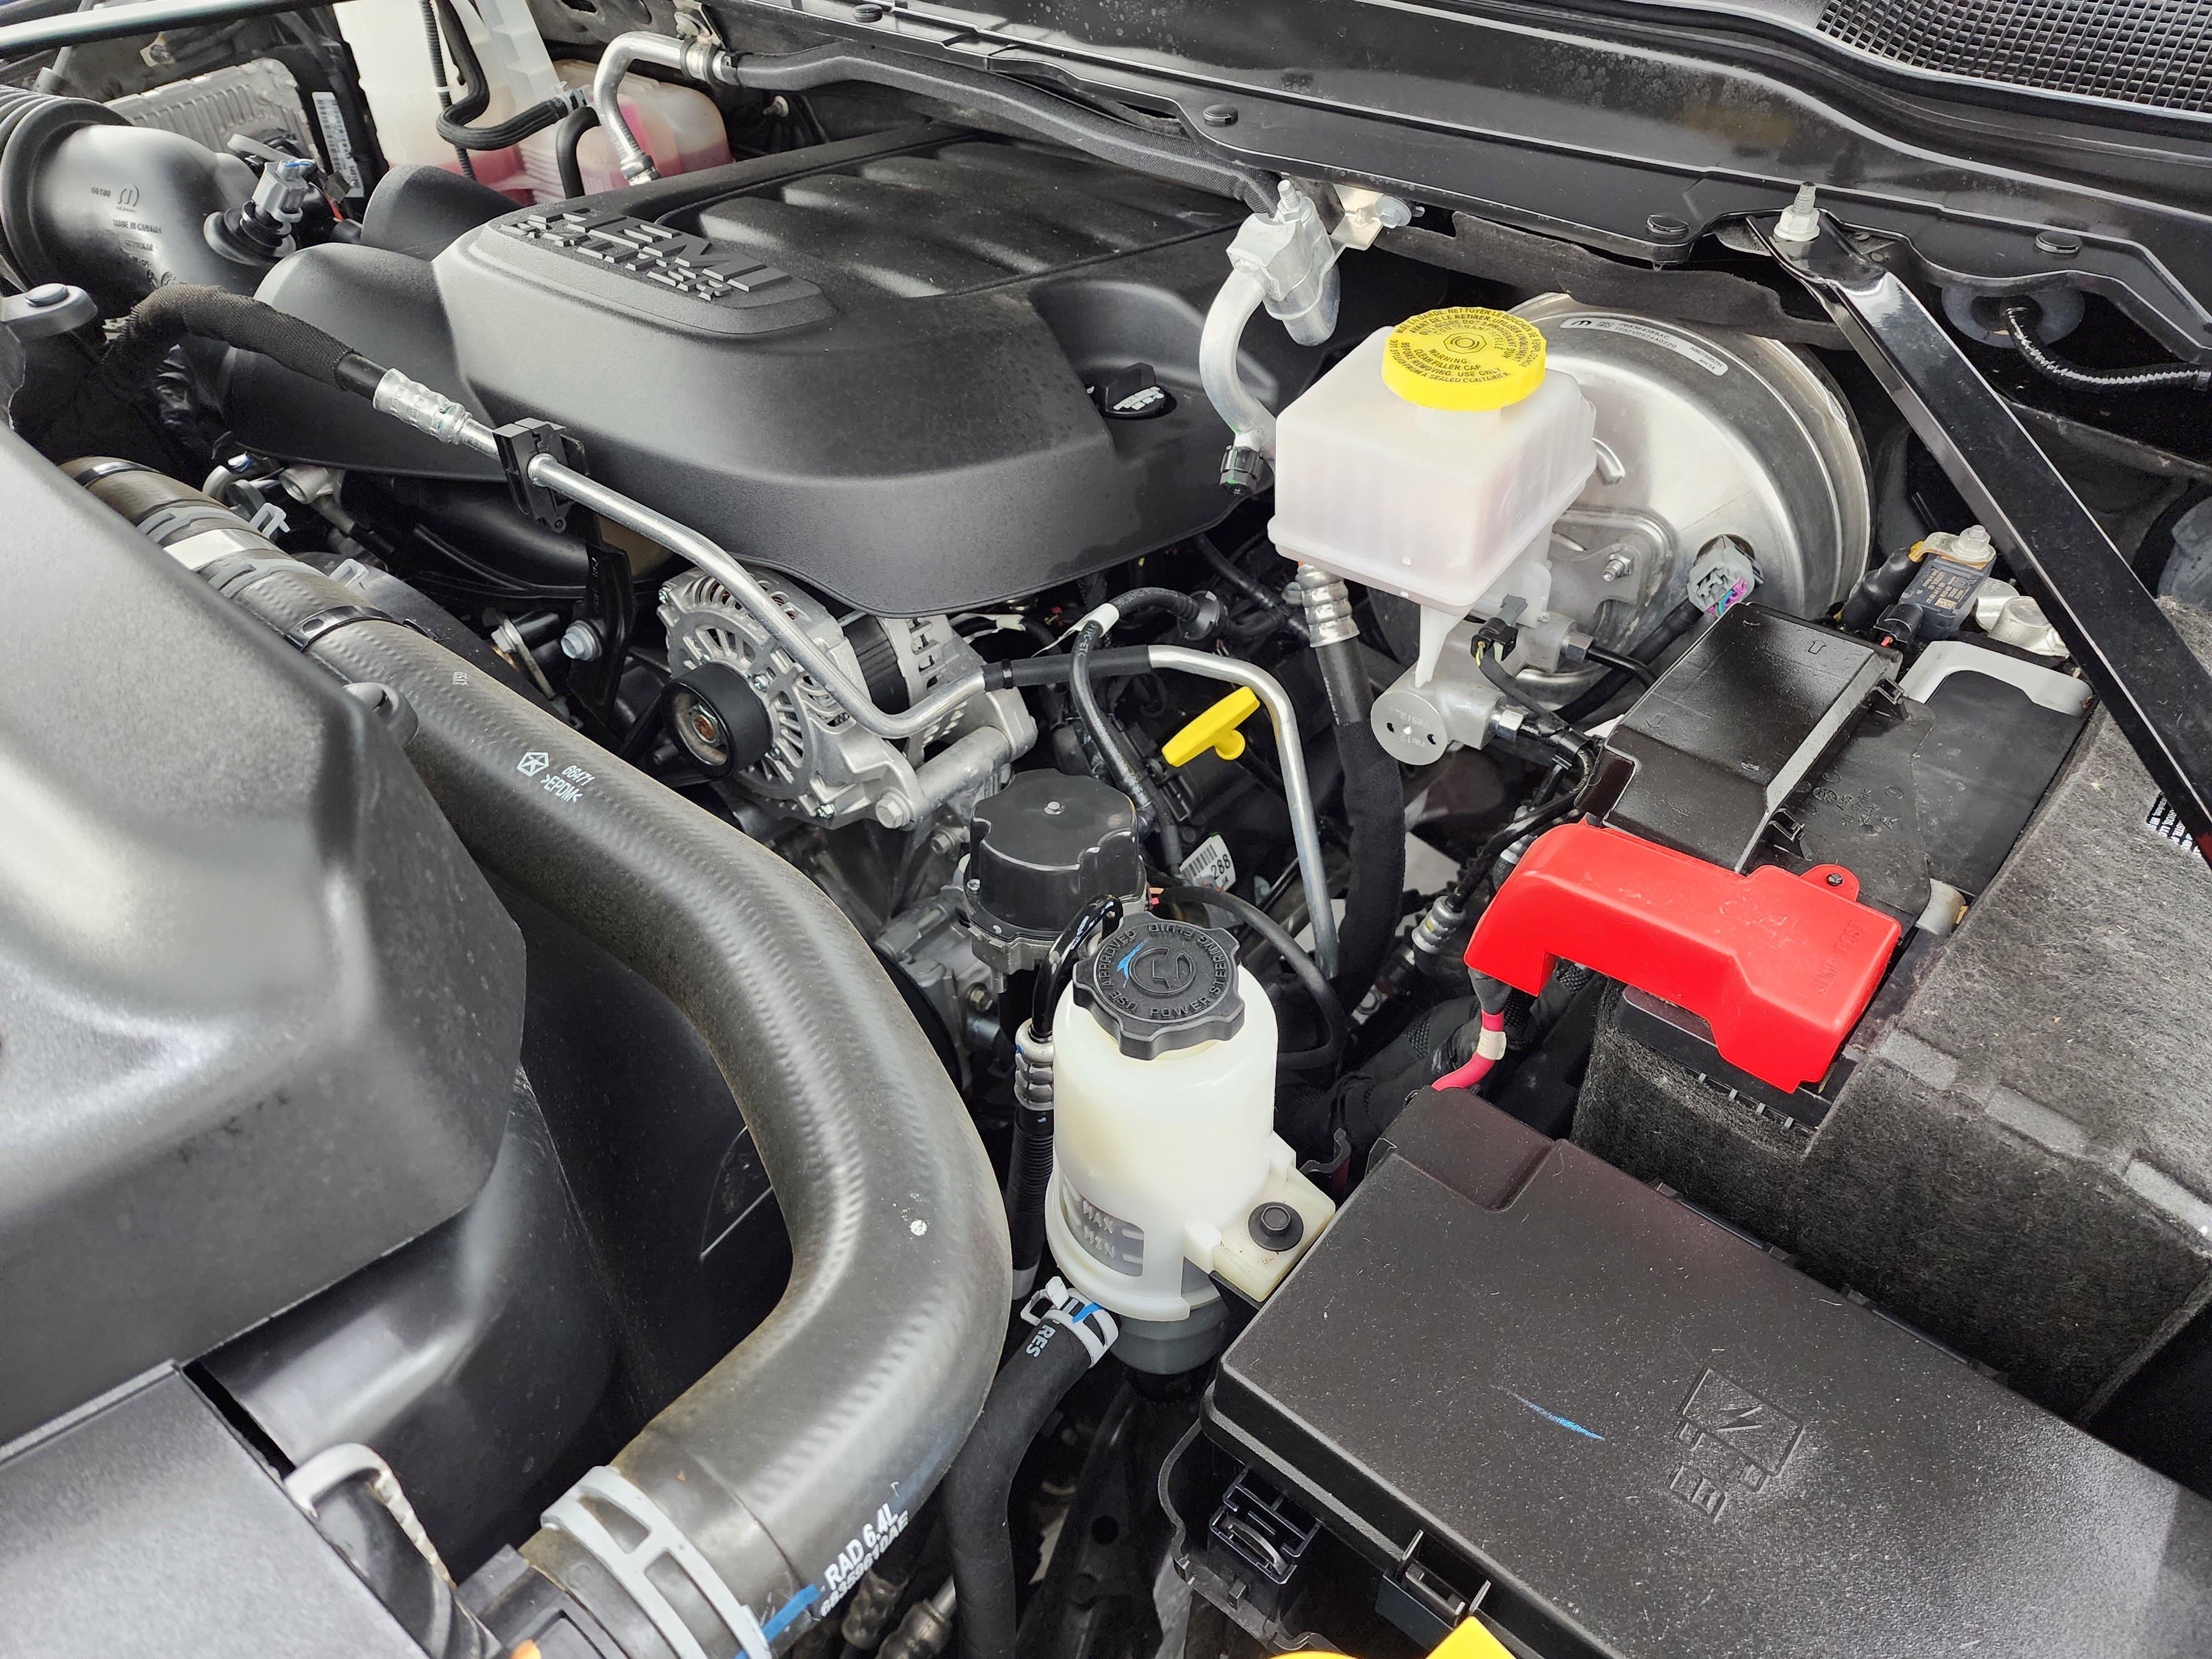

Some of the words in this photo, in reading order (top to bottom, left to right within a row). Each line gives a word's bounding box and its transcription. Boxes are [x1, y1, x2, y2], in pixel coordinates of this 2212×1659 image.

[527, 207, 793, 292] HEMI
[576, 240, 733, 301] LITER
[1395, 324, 1410, 333] MISE
[1417, 310, 1447, 320] GARDE:
[1502, 313, 1533, 332] BOUCHON
[1409, 321, 1430, 333] AVANT
[1492, 318, 1521, 333] UTILISER
[1389, 340, 1398, 348] DOT
[1391, 352, 1406, 364] FLUID
[1401, 342, 1416, 360] BEFORE
[1411, 359, 1453, 377] REMOVING.
[1478, 367, 1501, 377] ONLY
[1414, 349, 1434, 363] CLEAN
[1431, 360, 1460, 371] FILLER
[1428, 348, 1471, 364] WARNING:
[1402, 363, 1422, 375] FROM
[1428, 374, 1461, 383] SEALED
[561, 765, 595, 786] 66471
[1148, 924, 1195, 938] FLUID
[1099, 929, 1136, 988] APPROVED
[1197, 937, 1227, 995] STEERING
[1813, 958, 1840, 995] JUMP
[1834, 920, 1867, 955] POST
[1108, 990, 1138, 1011] USE
[1150, 996, 1211, 1018] POWER
[1082, 1199, 1114, 1234] MAX
[1084, 1225, 1115, 1258] MIN
[1026, 1324, 1056, 1358] RES
[823, 1538, 865, 1591] RAD
[862, 1502, 899, 1548] 6.4L
